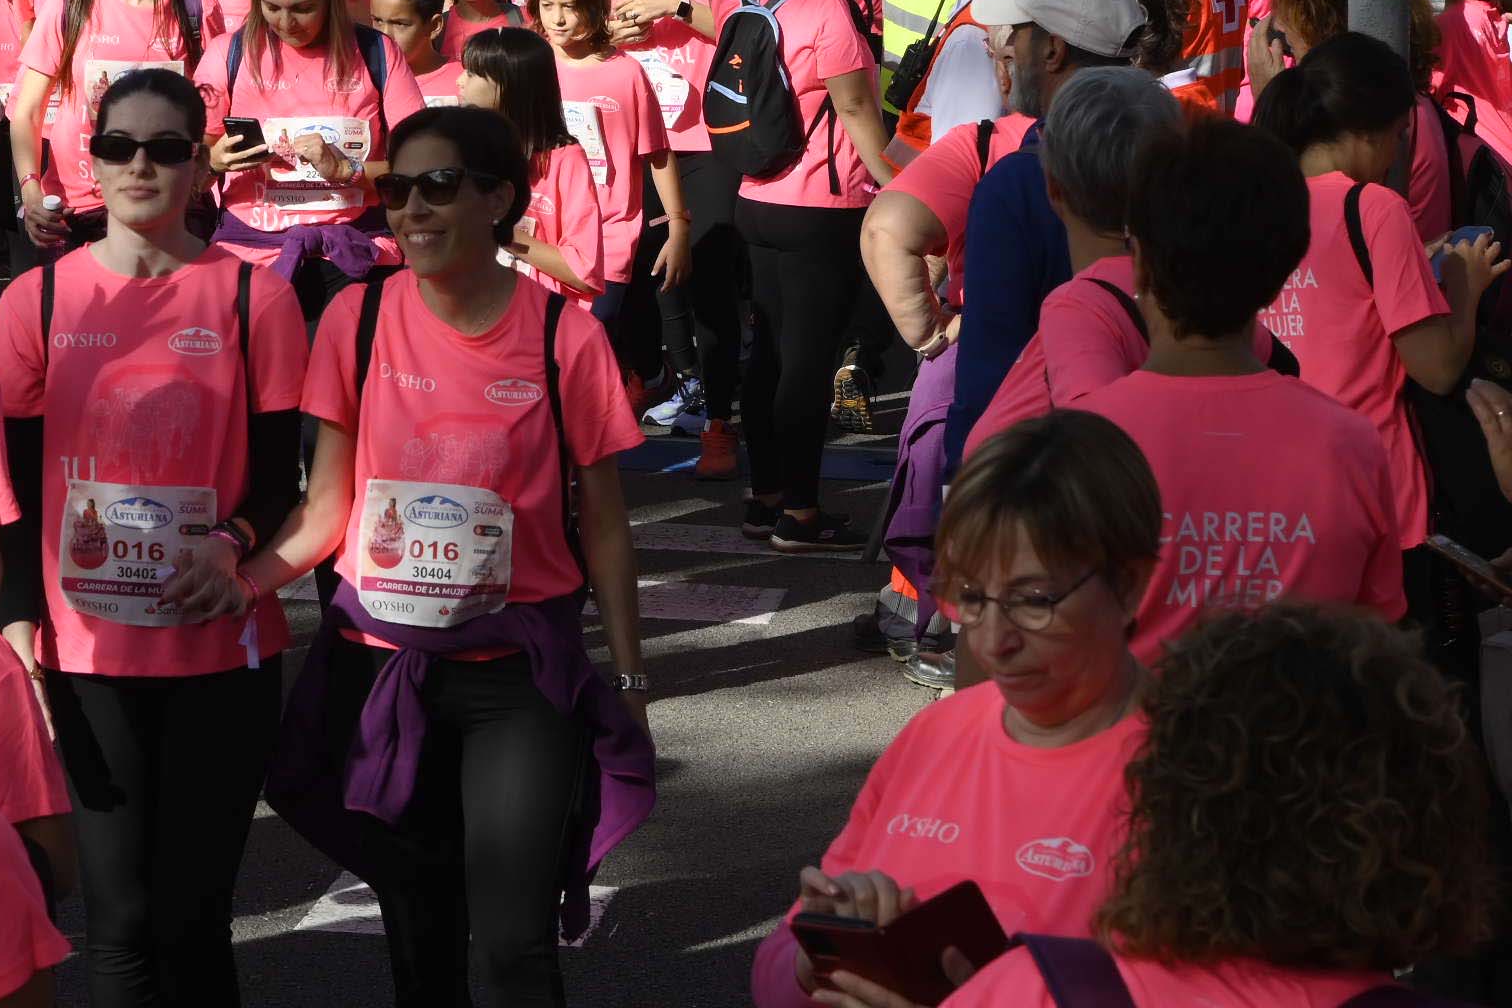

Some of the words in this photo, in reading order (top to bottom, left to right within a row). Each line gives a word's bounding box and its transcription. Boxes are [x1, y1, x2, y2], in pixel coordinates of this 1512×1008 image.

[1281, 291, 1301, 313] LA
[1264, 314, 1305, 338] UJER
[54, 332, 117, 349] OYSHO
[379, 362, 437, 393] OYSHO
[110, 507, 168, 523] ASTURIANA
[409, 506, 464, 522] ASTURIANA
[473, 505, 505, 517] SUMA
[1159, 511, 1316, 545] CARRERA
[112, 539, 166, 562] 016
[409, 539, 460, 562] 016
[1179, 544, 1224, 576] DE
[1236, 544, 1280, 576] LA
[412, 566, 452, 580] 30404
[76, 581, 119, 592] CARRERA
[120, 584, 133, 593] DE
[134, 585, 147, 594] LA
[147, 586, 167, 595] MU
[376, 580, 414, 592] CARRERA
[415, 585, 427, 595] DE
[428, 586, 441, 596] LA
[372, 599, 416, 614] OYSHO
